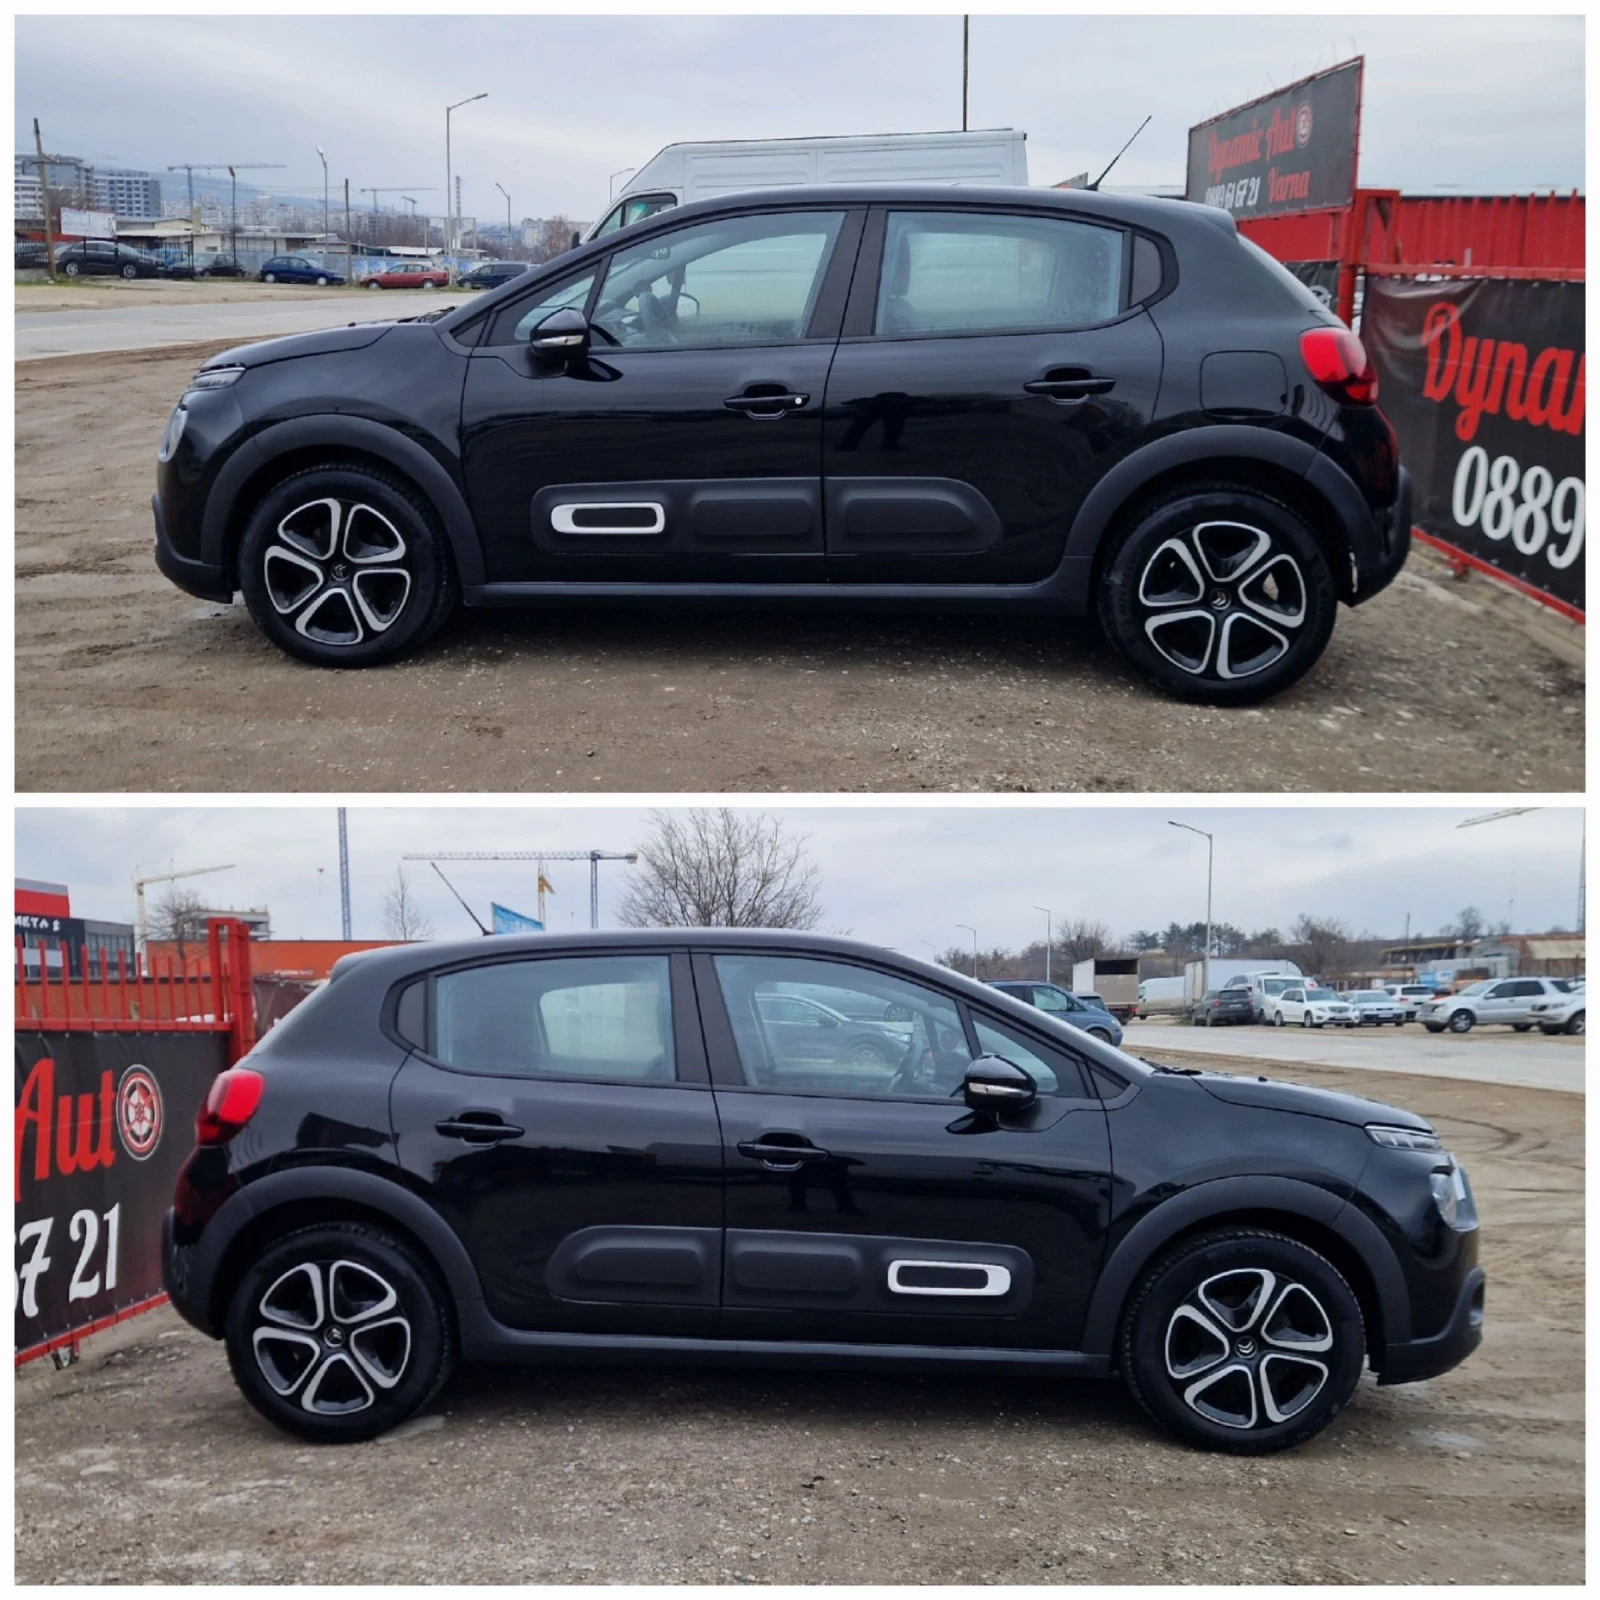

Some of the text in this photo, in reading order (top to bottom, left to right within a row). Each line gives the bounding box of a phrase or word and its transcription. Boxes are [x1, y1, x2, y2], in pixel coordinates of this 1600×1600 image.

[1208, 117, 1263, 184] Dynamic
[1247, 176, 1261, 206] 21
[1268, 166, 1311, 203] Varna
[1452, 446, 1585, 570] 0889
[15, 1201, 120, 1318] 7 21
